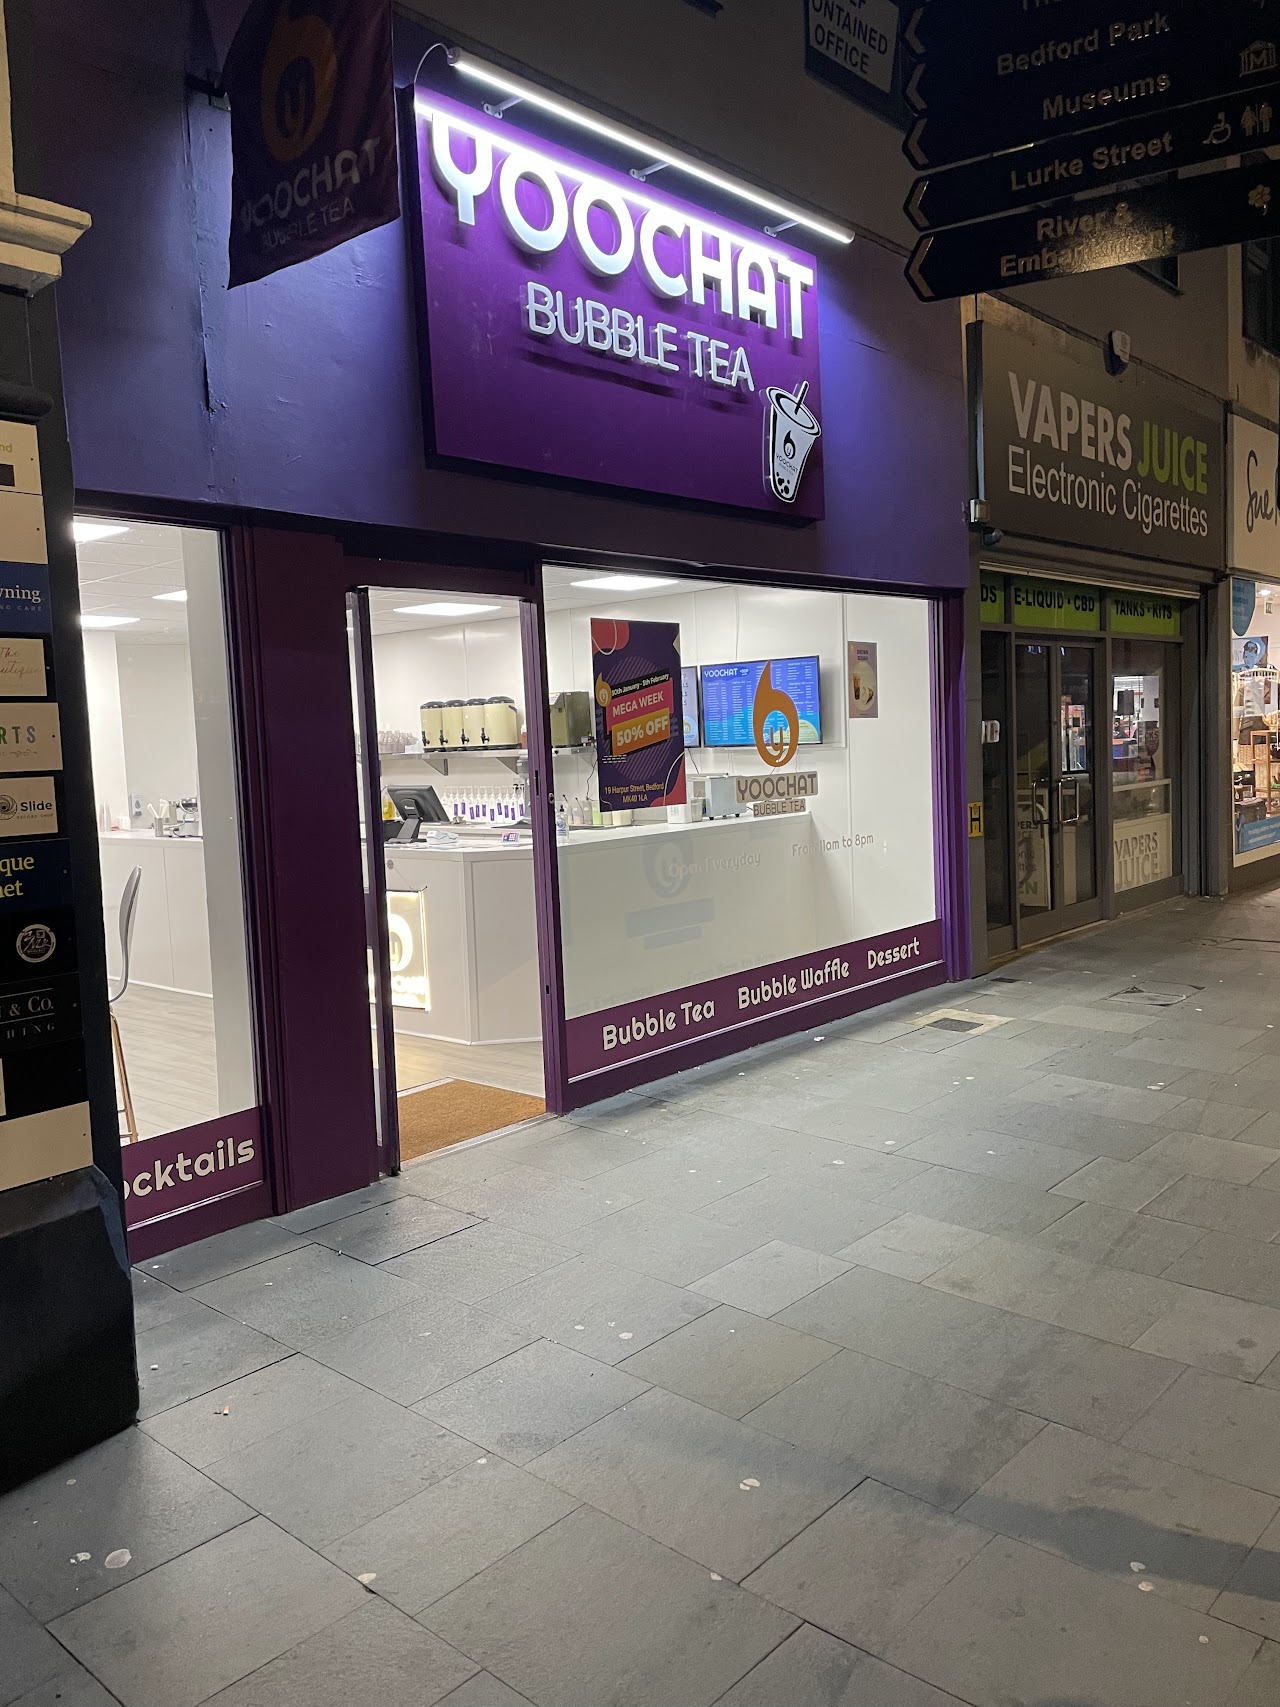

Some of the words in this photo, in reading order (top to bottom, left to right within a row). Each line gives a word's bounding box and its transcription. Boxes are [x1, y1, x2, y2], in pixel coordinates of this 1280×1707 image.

[815, 24, 869, 74] OFFICE
[996, 28, 1099, 76] Bedford
[1109, 12, 1170, 46] Park
[1042, 72, 1171, 120] Museums
[1010, 157, 1084, 191] Lurke
[1092, 130, 1173, 170] Street
[431, 113, 814, 339] YOOCHAT
[1036, 208, 1108, 241] River
[1113, 200, 1134, 226] &
[999, 223, 1175, 278] Embankment
[526, 281, 679, 371] BUBBLE
[687, 331, 754, 392] TEA
[1008, 371, 1132, 471] VAPERS
[1137, 421, 1208, 494] JUICE
[1008, 444, 1117, 516] Electronic
[1122, 478, 1208, 537] Cigarettes
[1014, 587, 1064, 609] E-LIQUID
[1074, 594, 1095, 612] CBD
[1115, 599, 1145, 617] TANKS
[1152, 603, 1172, 619] KITS
[704, 668, 738, 678] YOOCHAT
[612, 700, 638, 717] MEGA
[639, 691, 664, 708] WEEK
[616, 724, 644, 747] 50%
[645, 715, 669, 736] OFF
[604, 786, 612, 795] 19
[737, 774, 817, 801] YOOCHAT
[20, 800, 52, 812] Slide
[753, 801, 787, 816] BUBBLE
[789, 799, 806, 812] TEA
[970, 805, 982, 834] H
[842, 836, 853, 848] to
[855, 833, 874, 847] 8pm
[1114, 832, 1158, 860] VAPERS
[1115, 852, 1159, 889] JUICE
[602, 1008, 676, 1051] Bubble
[681, 999, 715, 1025] Tea
[738, 974, 797, 1010] Bubble
[800, 957, 850, 991] Waffle
[867, 936, 921, 970] Dessert
[8, 1003, 21, 1017] &
